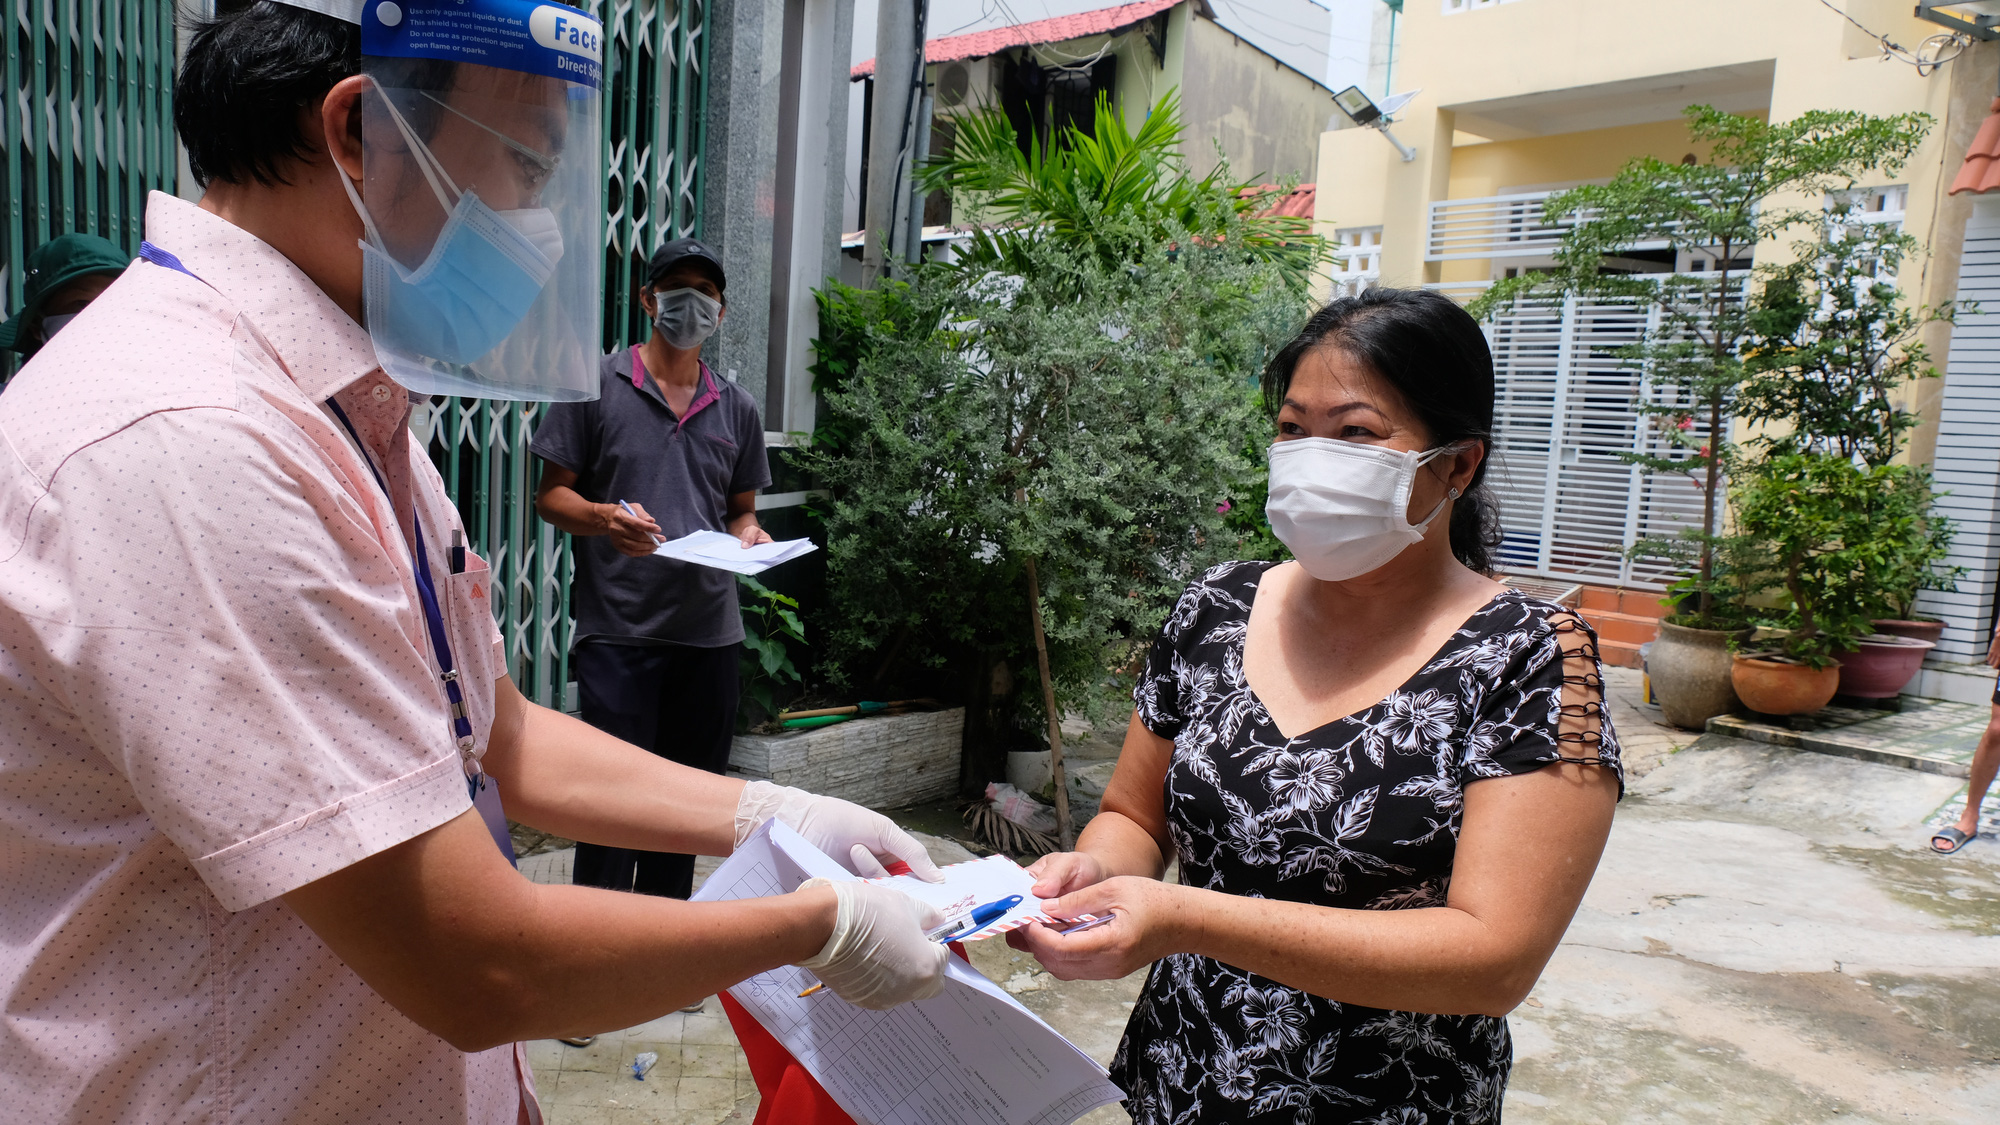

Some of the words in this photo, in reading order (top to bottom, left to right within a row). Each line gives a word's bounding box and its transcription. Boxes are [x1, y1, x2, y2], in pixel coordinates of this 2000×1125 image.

[472, 12, 496, 21] liquids
[507, 18, 524, 26] dust.
[474, 23, 498, 33] impact
[500, 29, 530, 40] resistant.
[555, 16, 597, 52] Face
[430, 42, 451, 50] flame
[462, 46, 489, 56] sparks.
[462, 35, 498, 46] protection
[500, 41, 524, 50] against
[557, 55, 588, 75] Direct
